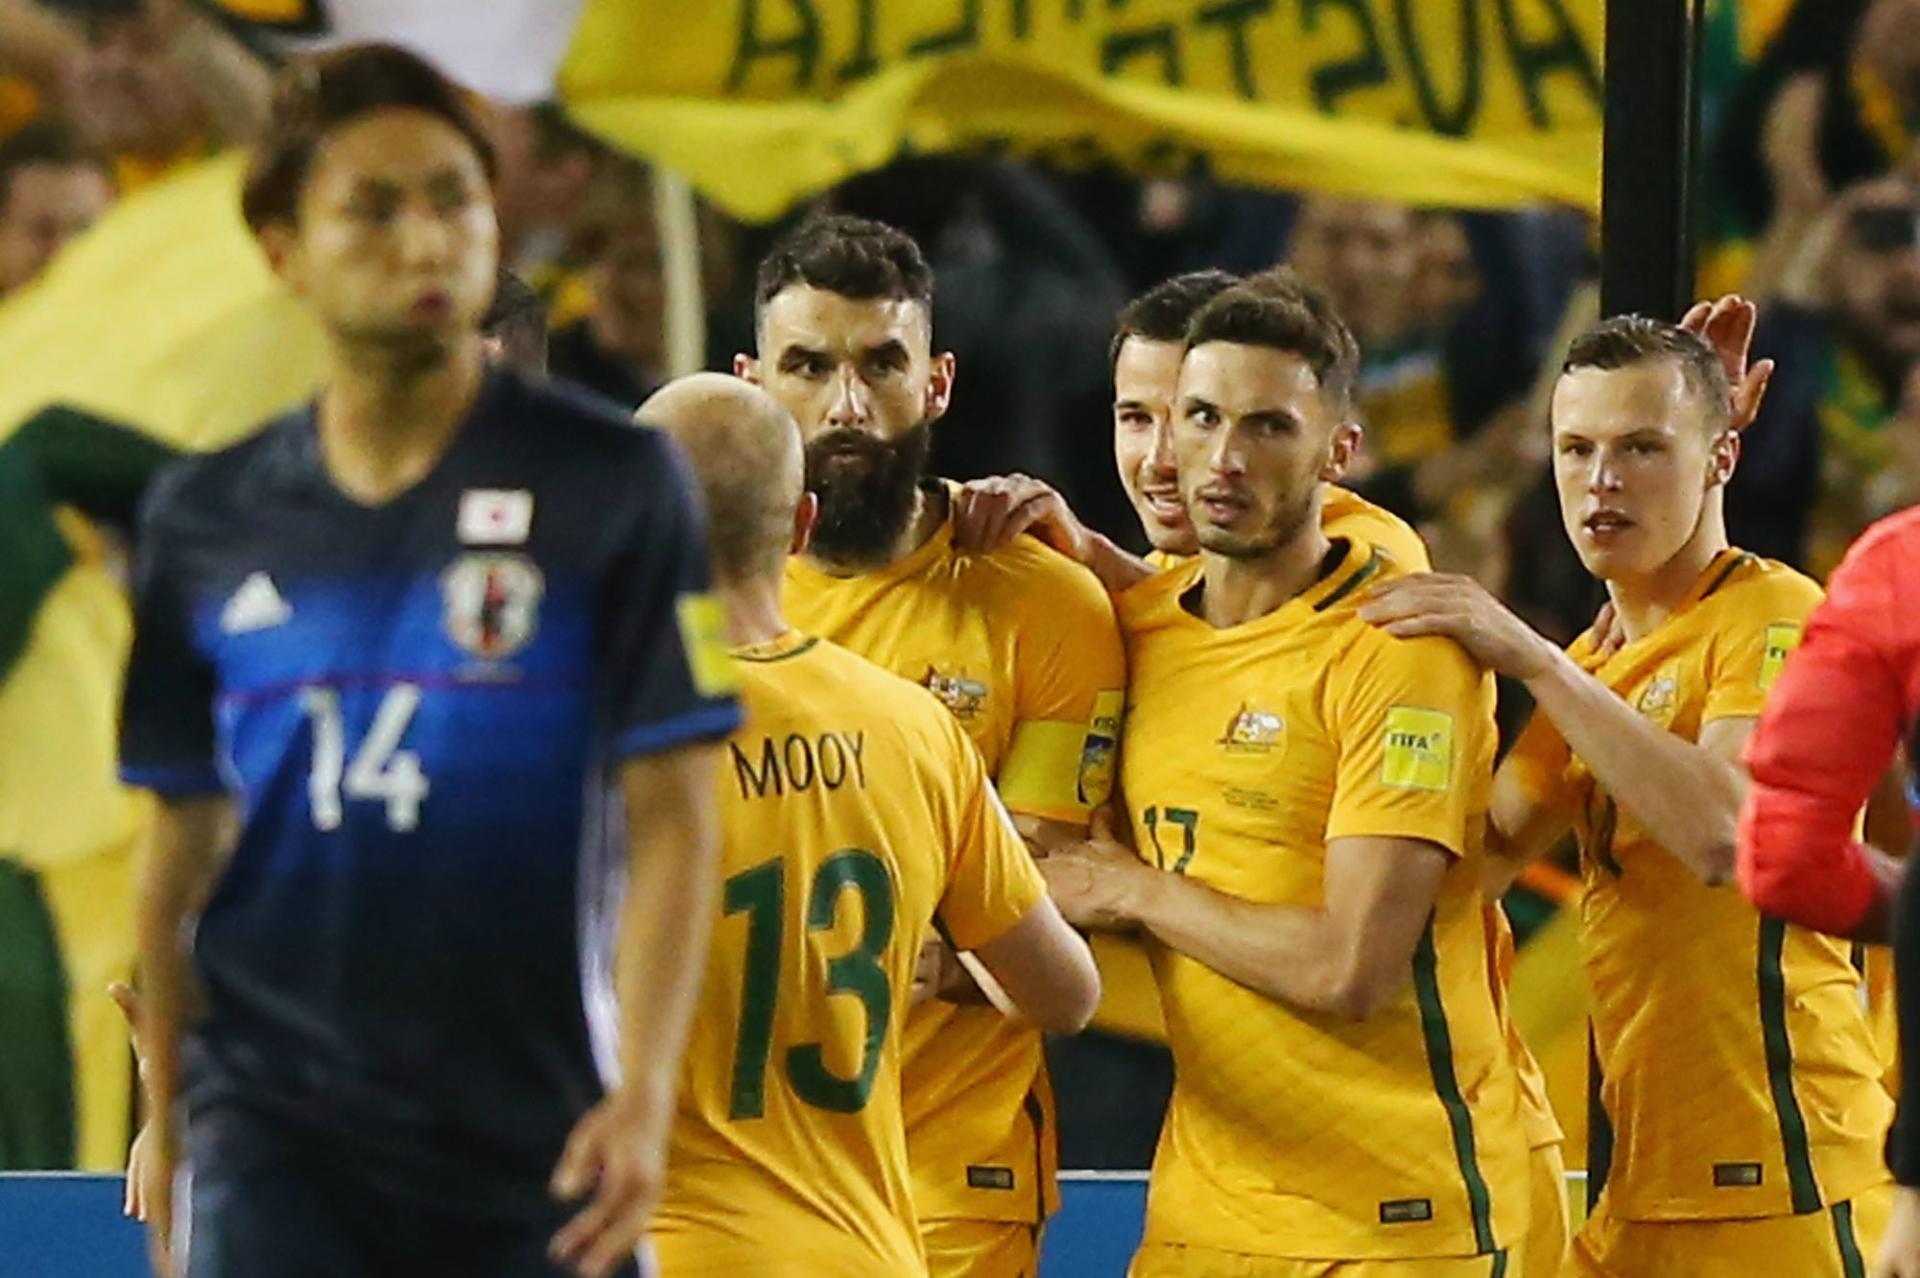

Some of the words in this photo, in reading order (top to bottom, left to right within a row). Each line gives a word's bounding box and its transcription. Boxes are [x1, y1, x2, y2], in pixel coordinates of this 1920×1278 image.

[299, 682, 428, 832] 14
[729, 730, 867, 801] MOOY
[1389, 732, 1429, 750] FIFA
[1143, 805, 1198, 873] 17
[722, 848, 896, 1120] 13
